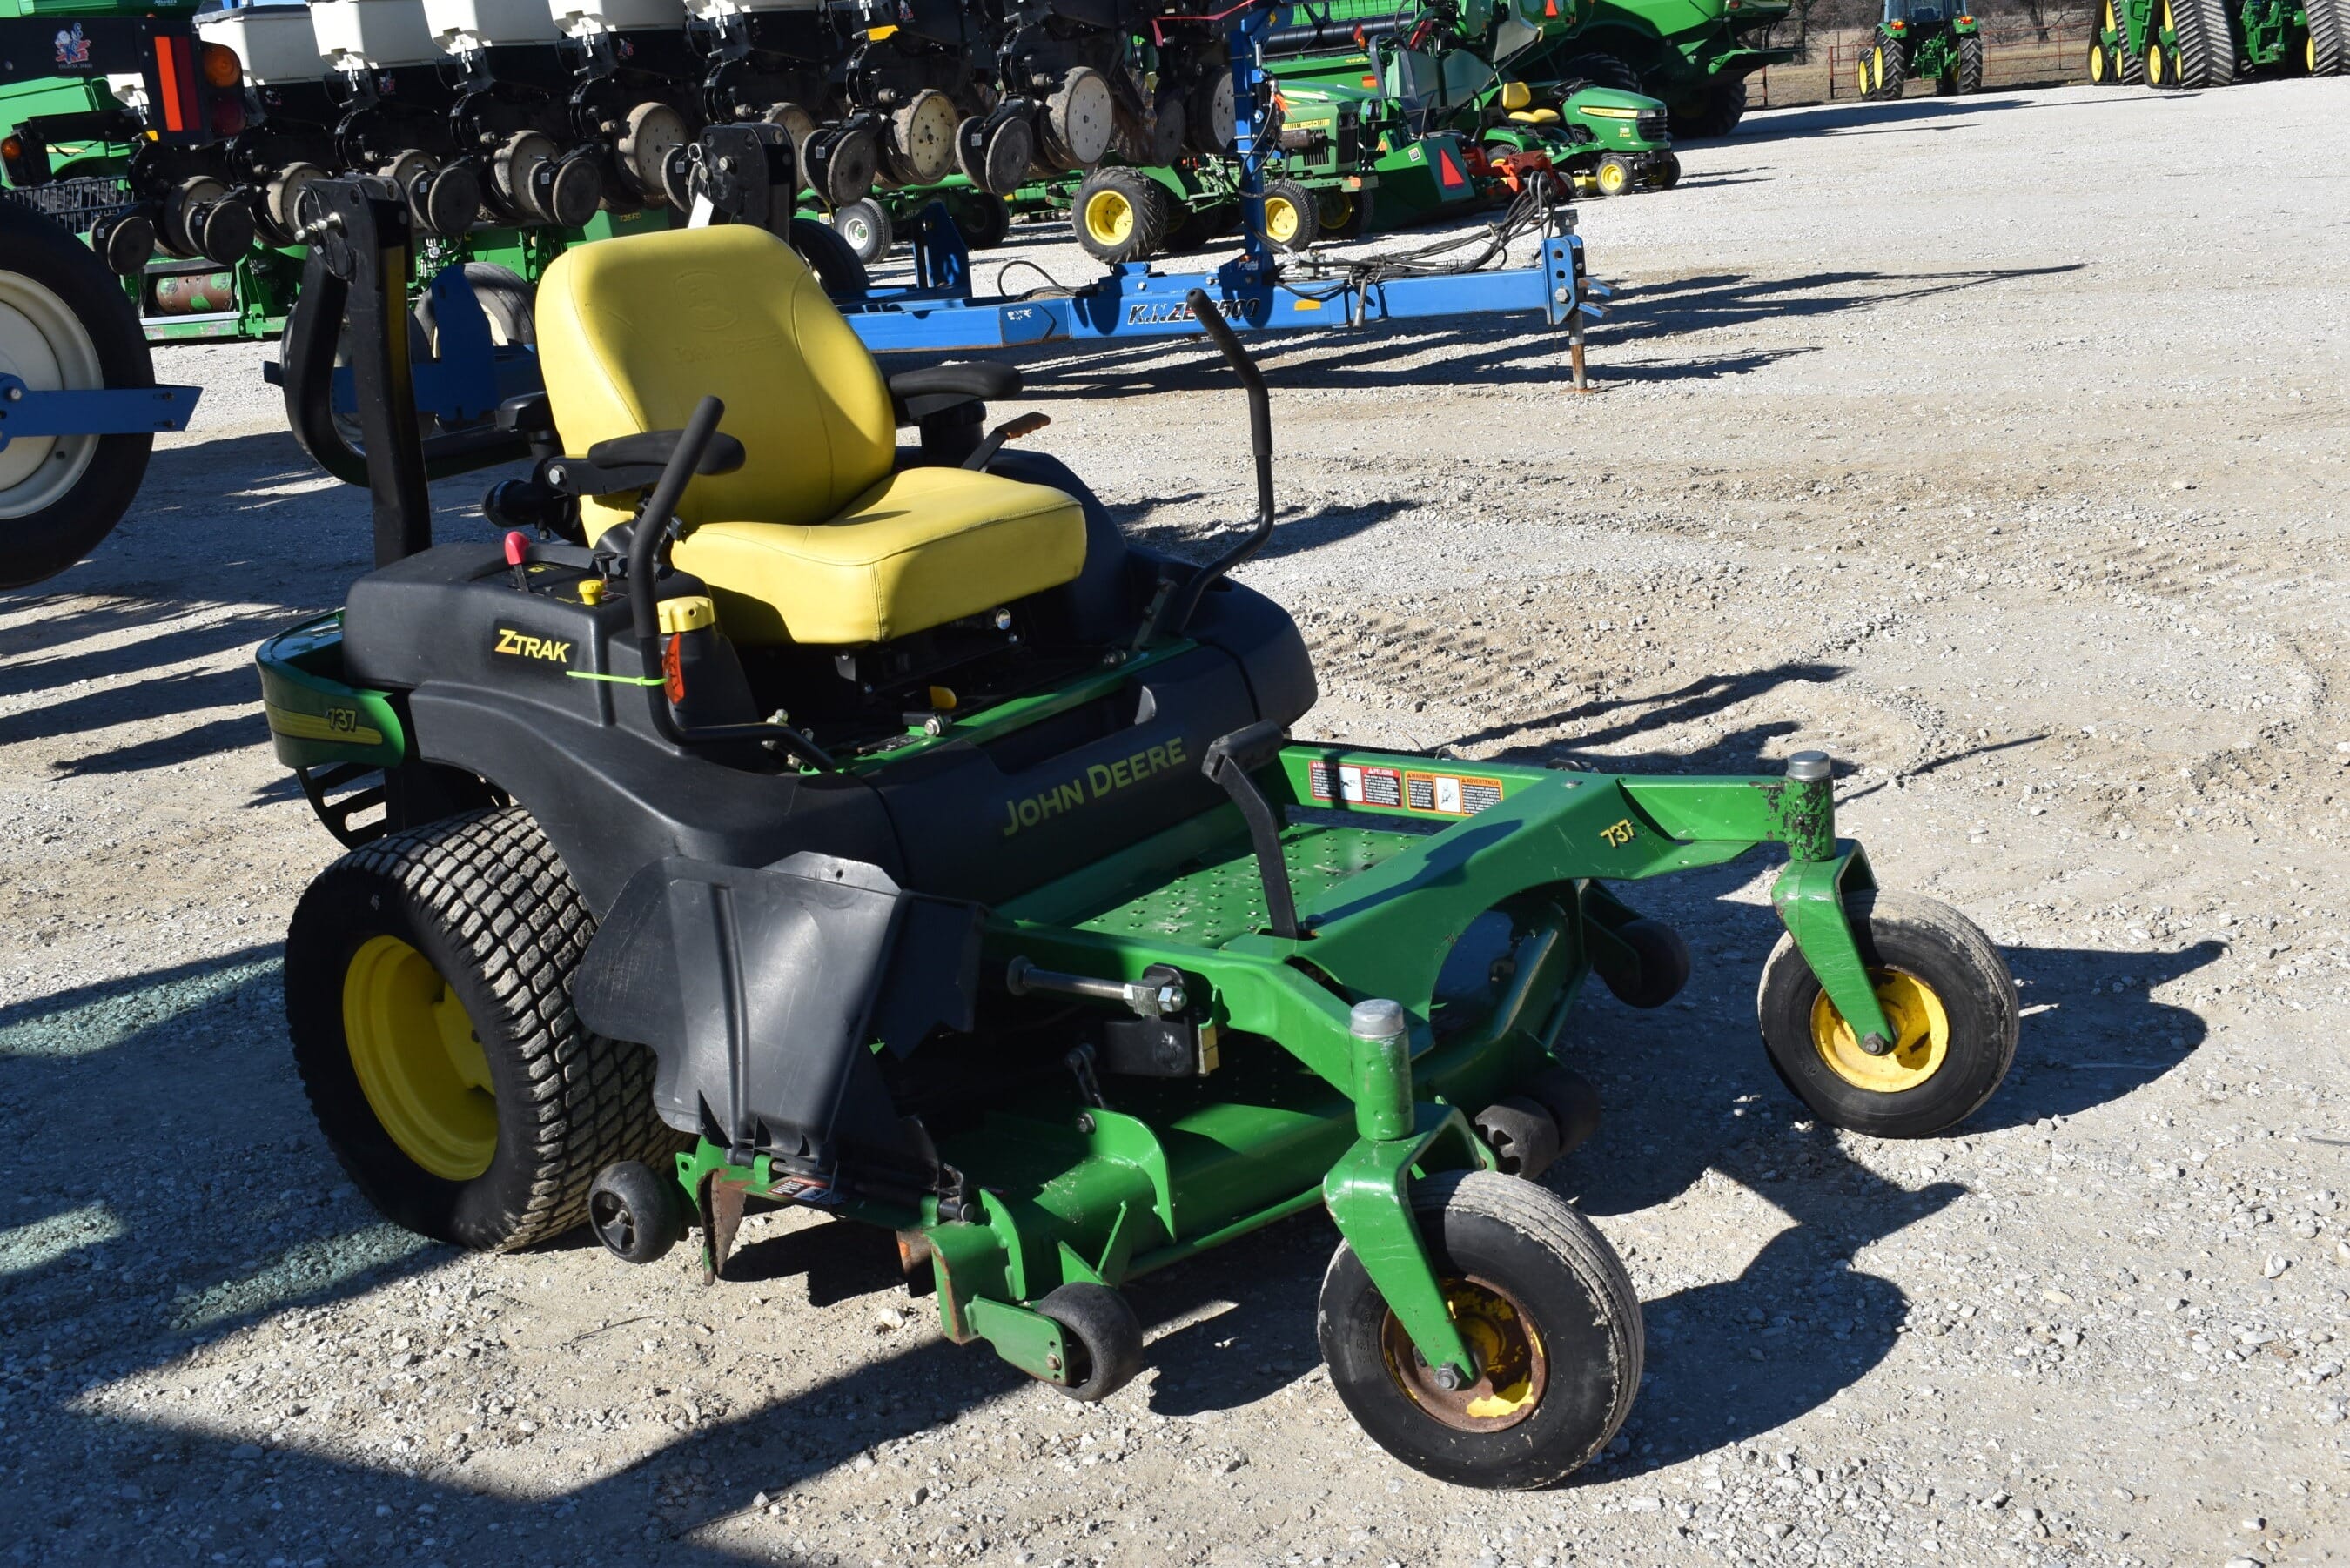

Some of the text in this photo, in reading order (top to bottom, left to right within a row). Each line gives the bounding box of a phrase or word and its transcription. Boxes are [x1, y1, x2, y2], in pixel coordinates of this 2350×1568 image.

[494, 628, 571, 663] ZTRAK
[1003, 737, 1186, 836] JOHN DEERE
[1599, 819, 1635, 848] 737
